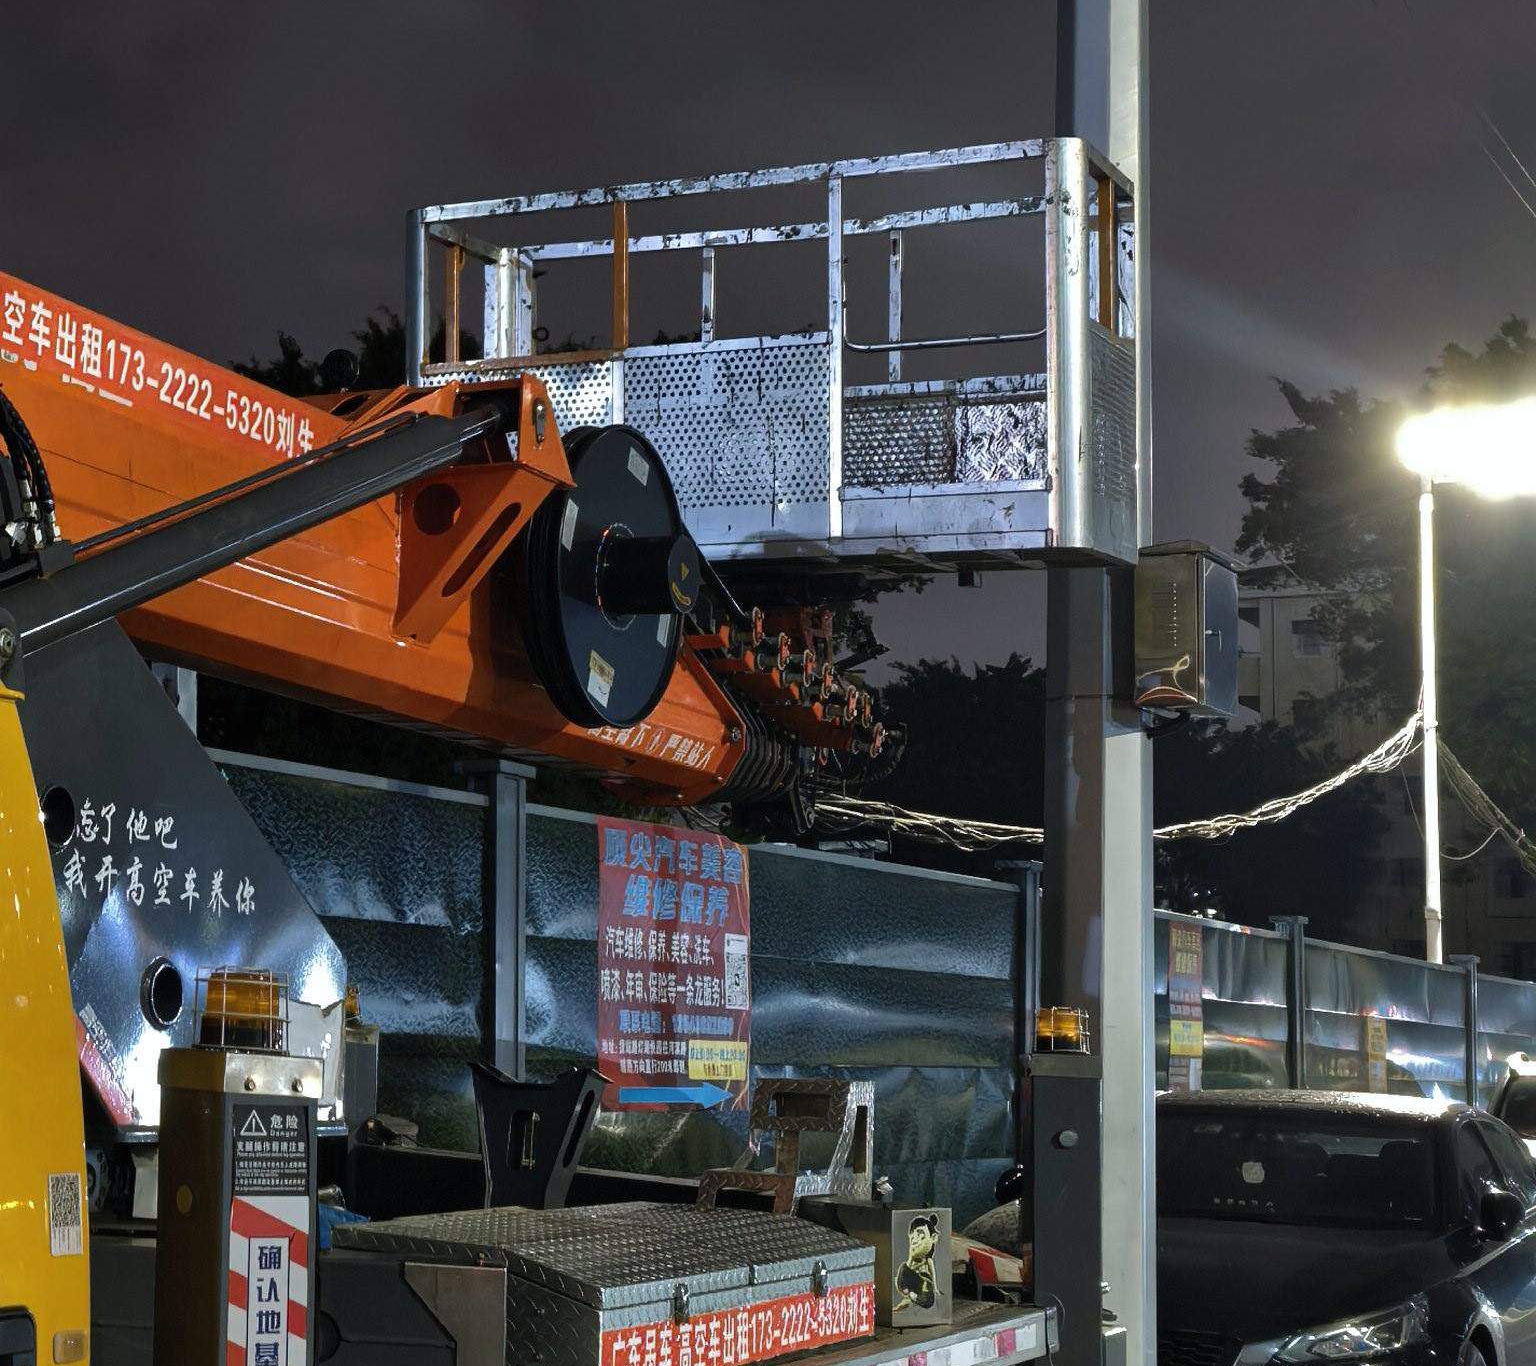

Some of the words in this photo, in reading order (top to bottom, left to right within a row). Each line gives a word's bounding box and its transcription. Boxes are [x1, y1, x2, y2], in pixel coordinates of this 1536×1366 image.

[64, 796, 178, 849] 忘了他吧
[63, 848, 256, 916] 我开高空车养你
[270, 1114, 298, 1129] 危险
